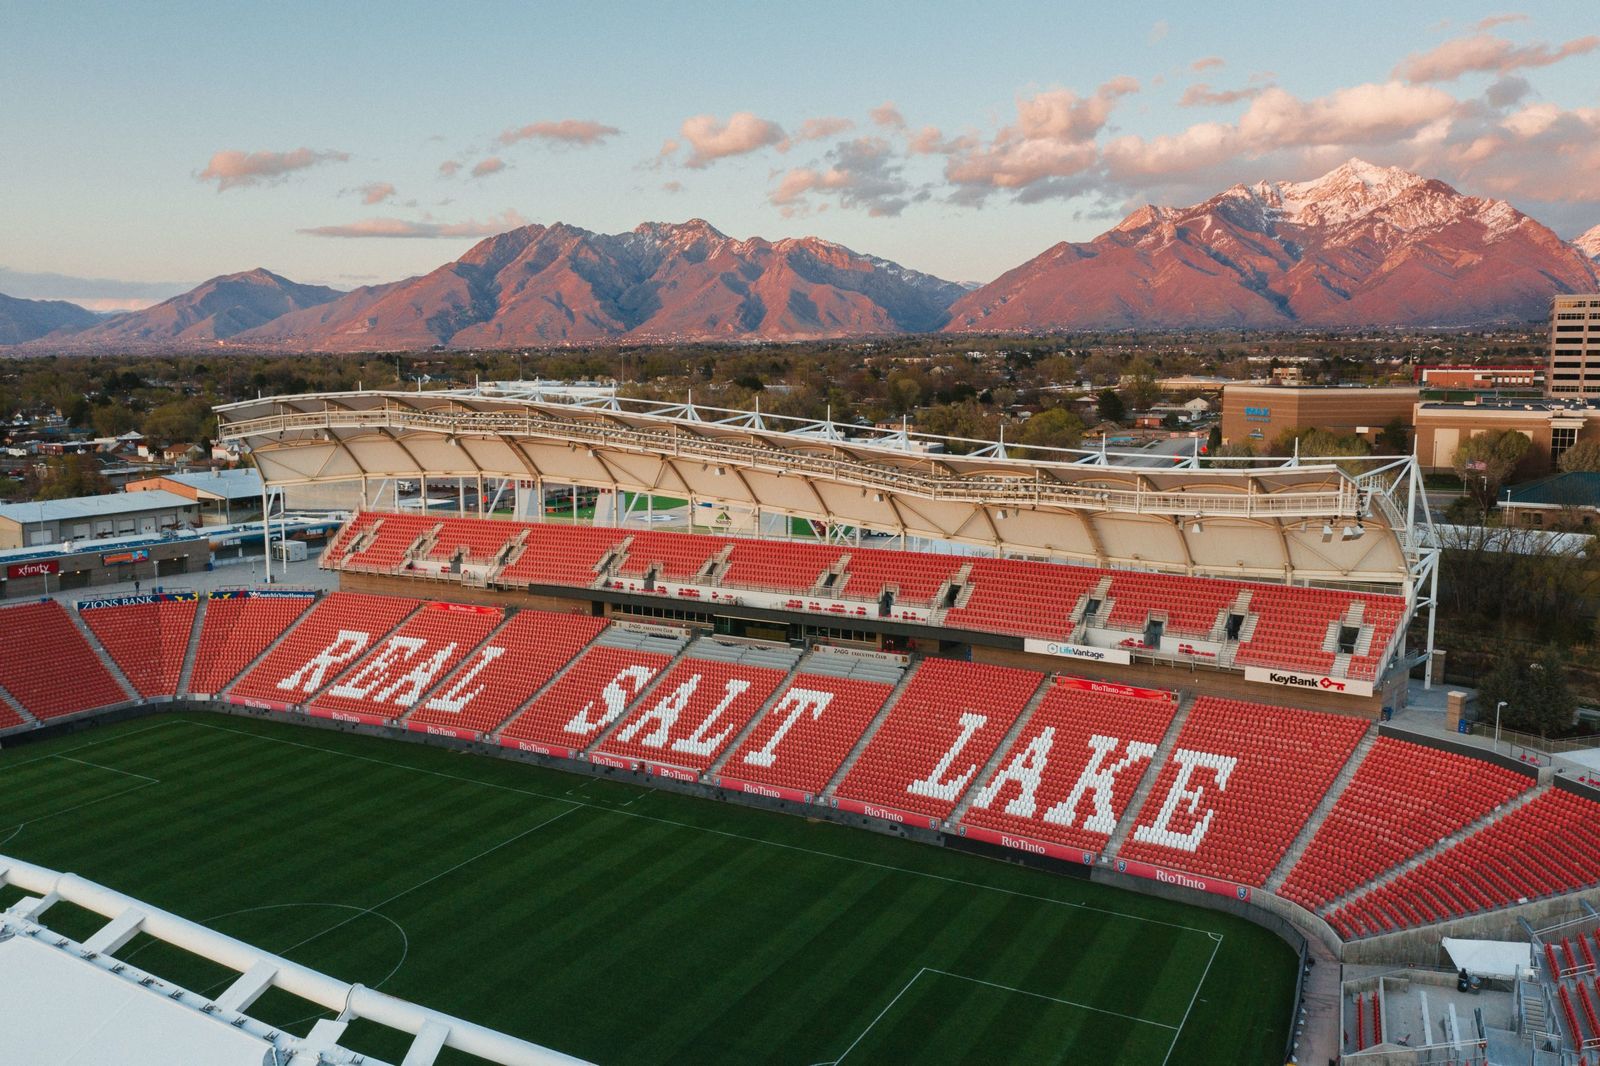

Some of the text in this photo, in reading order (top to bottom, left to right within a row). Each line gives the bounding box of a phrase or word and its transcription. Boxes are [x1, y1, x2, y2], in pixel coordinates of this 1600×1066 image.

[18, 563, 49, 576] xfinity
[82, 595, 153, 610] ZIONS BANK
[1060, 646, 1105, 660] LifeVantage
[277, 629, 505, 713] REAL
[1270, 673, 1318, 688] KeyBank
[563, 665, 834, 767] SALT
[907, 712, 1237, 852] LAKE
